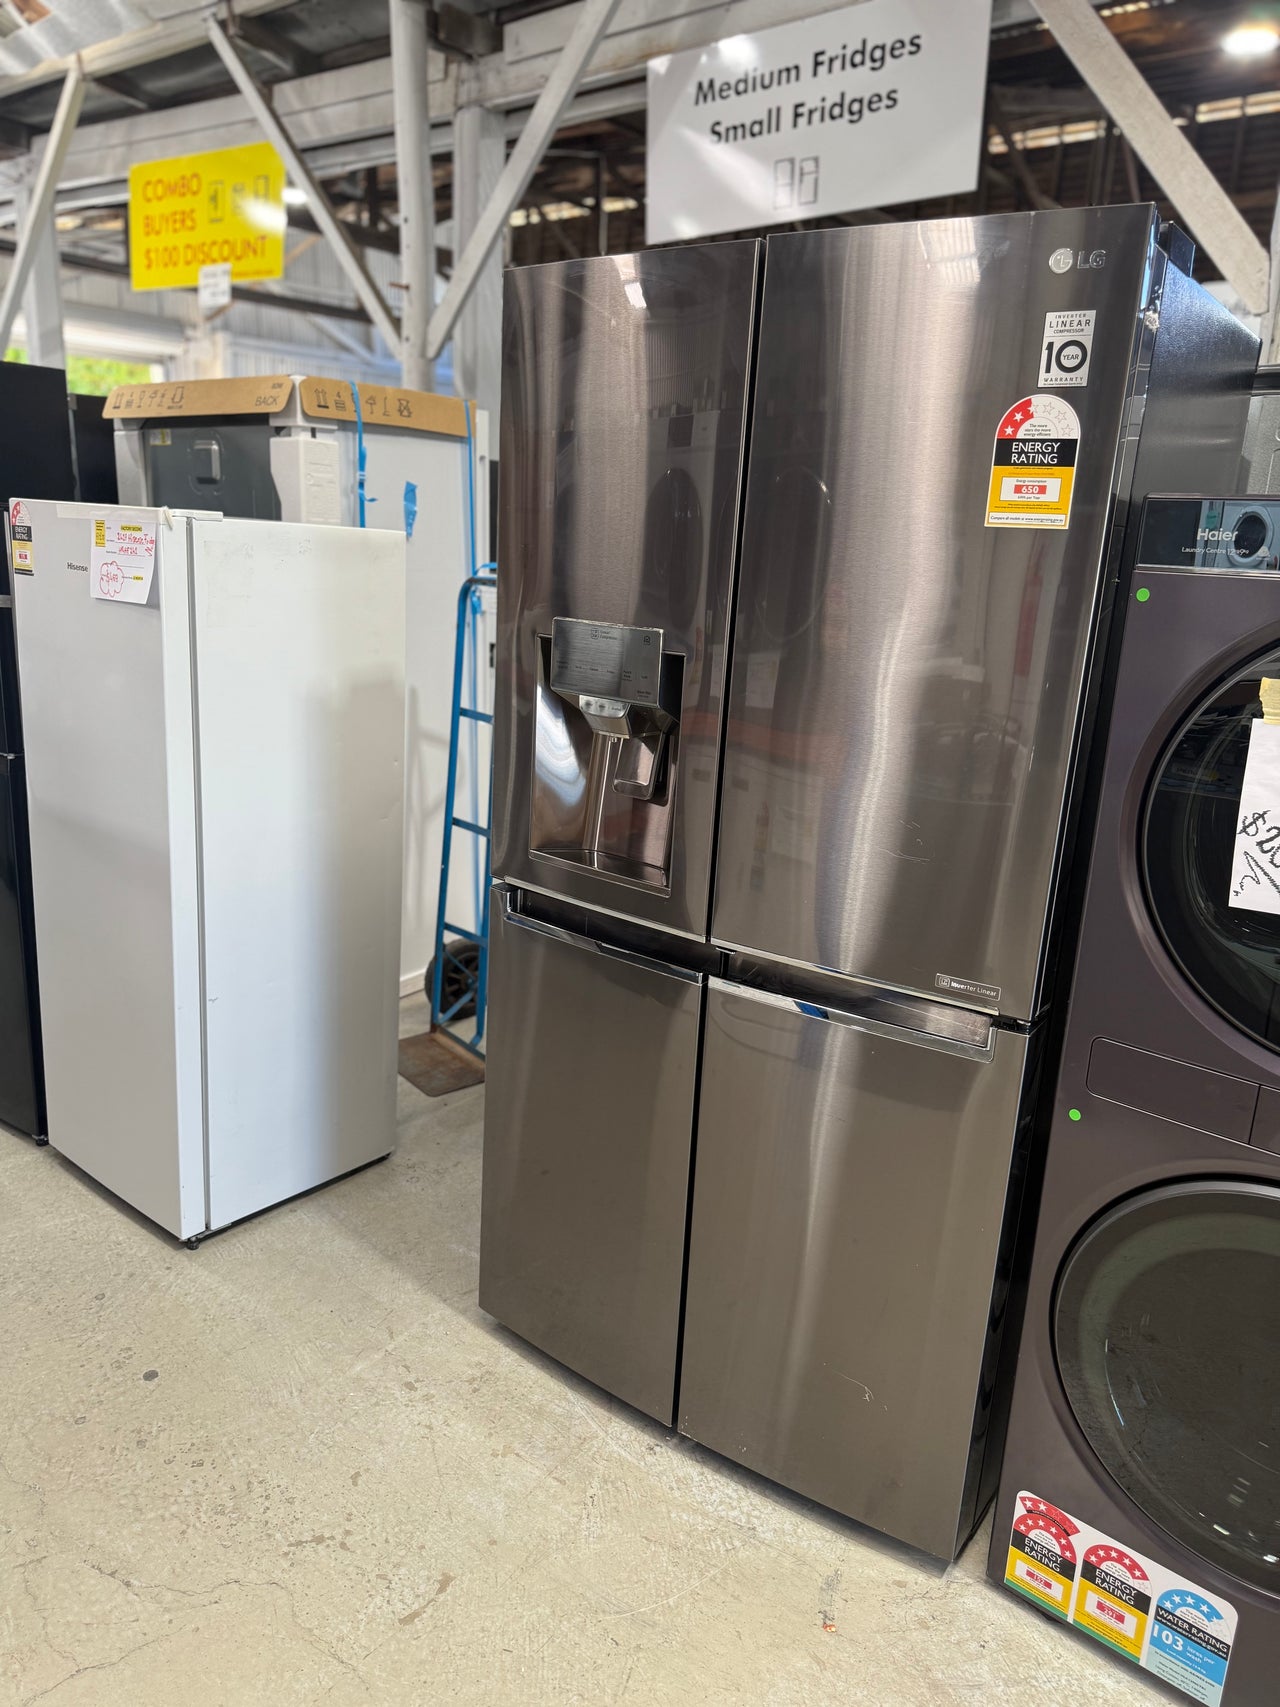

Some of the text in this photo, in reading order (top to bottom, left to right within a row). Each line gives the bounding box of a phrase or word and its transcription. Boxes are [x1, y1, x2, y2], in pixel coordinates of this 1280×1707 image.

[694, 34, 922, 105] Medium Fridges
[710, 89, 899, 144] Small Fridges
[142, 172, 202, 203] COMBO
[143, 209, 197, 237] BUYERS
[144, 235, 268, 270] $100 DISCOUNT
[1077, 249, 1107, 269] LG
[1049, 319, 1092, 329] LINEAR
[1045, 340, 1088, 373] 10
[255, 396, 280, 407] BACK
[1011, 453, 1058, 464] RATING
[1012, 442, 1061, 453] ENERGY
[1021, 486, 1039, 494] 650
[1197, 528, 1238, 541] Haier
[1181, 546, 1206, 554] Laundry
[67, 562, 89, 573] Hisense
[951, 981, 997, 996] Inverter Linear
[1024, 1546, 1060, 1572] RATING
[1025, 1537, 1063, 1561] ENERGY
[1095, 1578, 1134, 1605] RATING
[1096, 1569, 1137, 1596] ENERGY
[1104, 1607, 1116, 1619] 291
[1152, 1624, 1184, 1651] 103
[1156, 1616, 1227, 1658] www.waterrating.gov.au
[1158, 1608, 1190, 1631] WATER
[1191, 1627, 1228, 1652] RATING
[1186, 1652, 1202, 1663] wash
[1203, 1656, 1215, 1665] per
